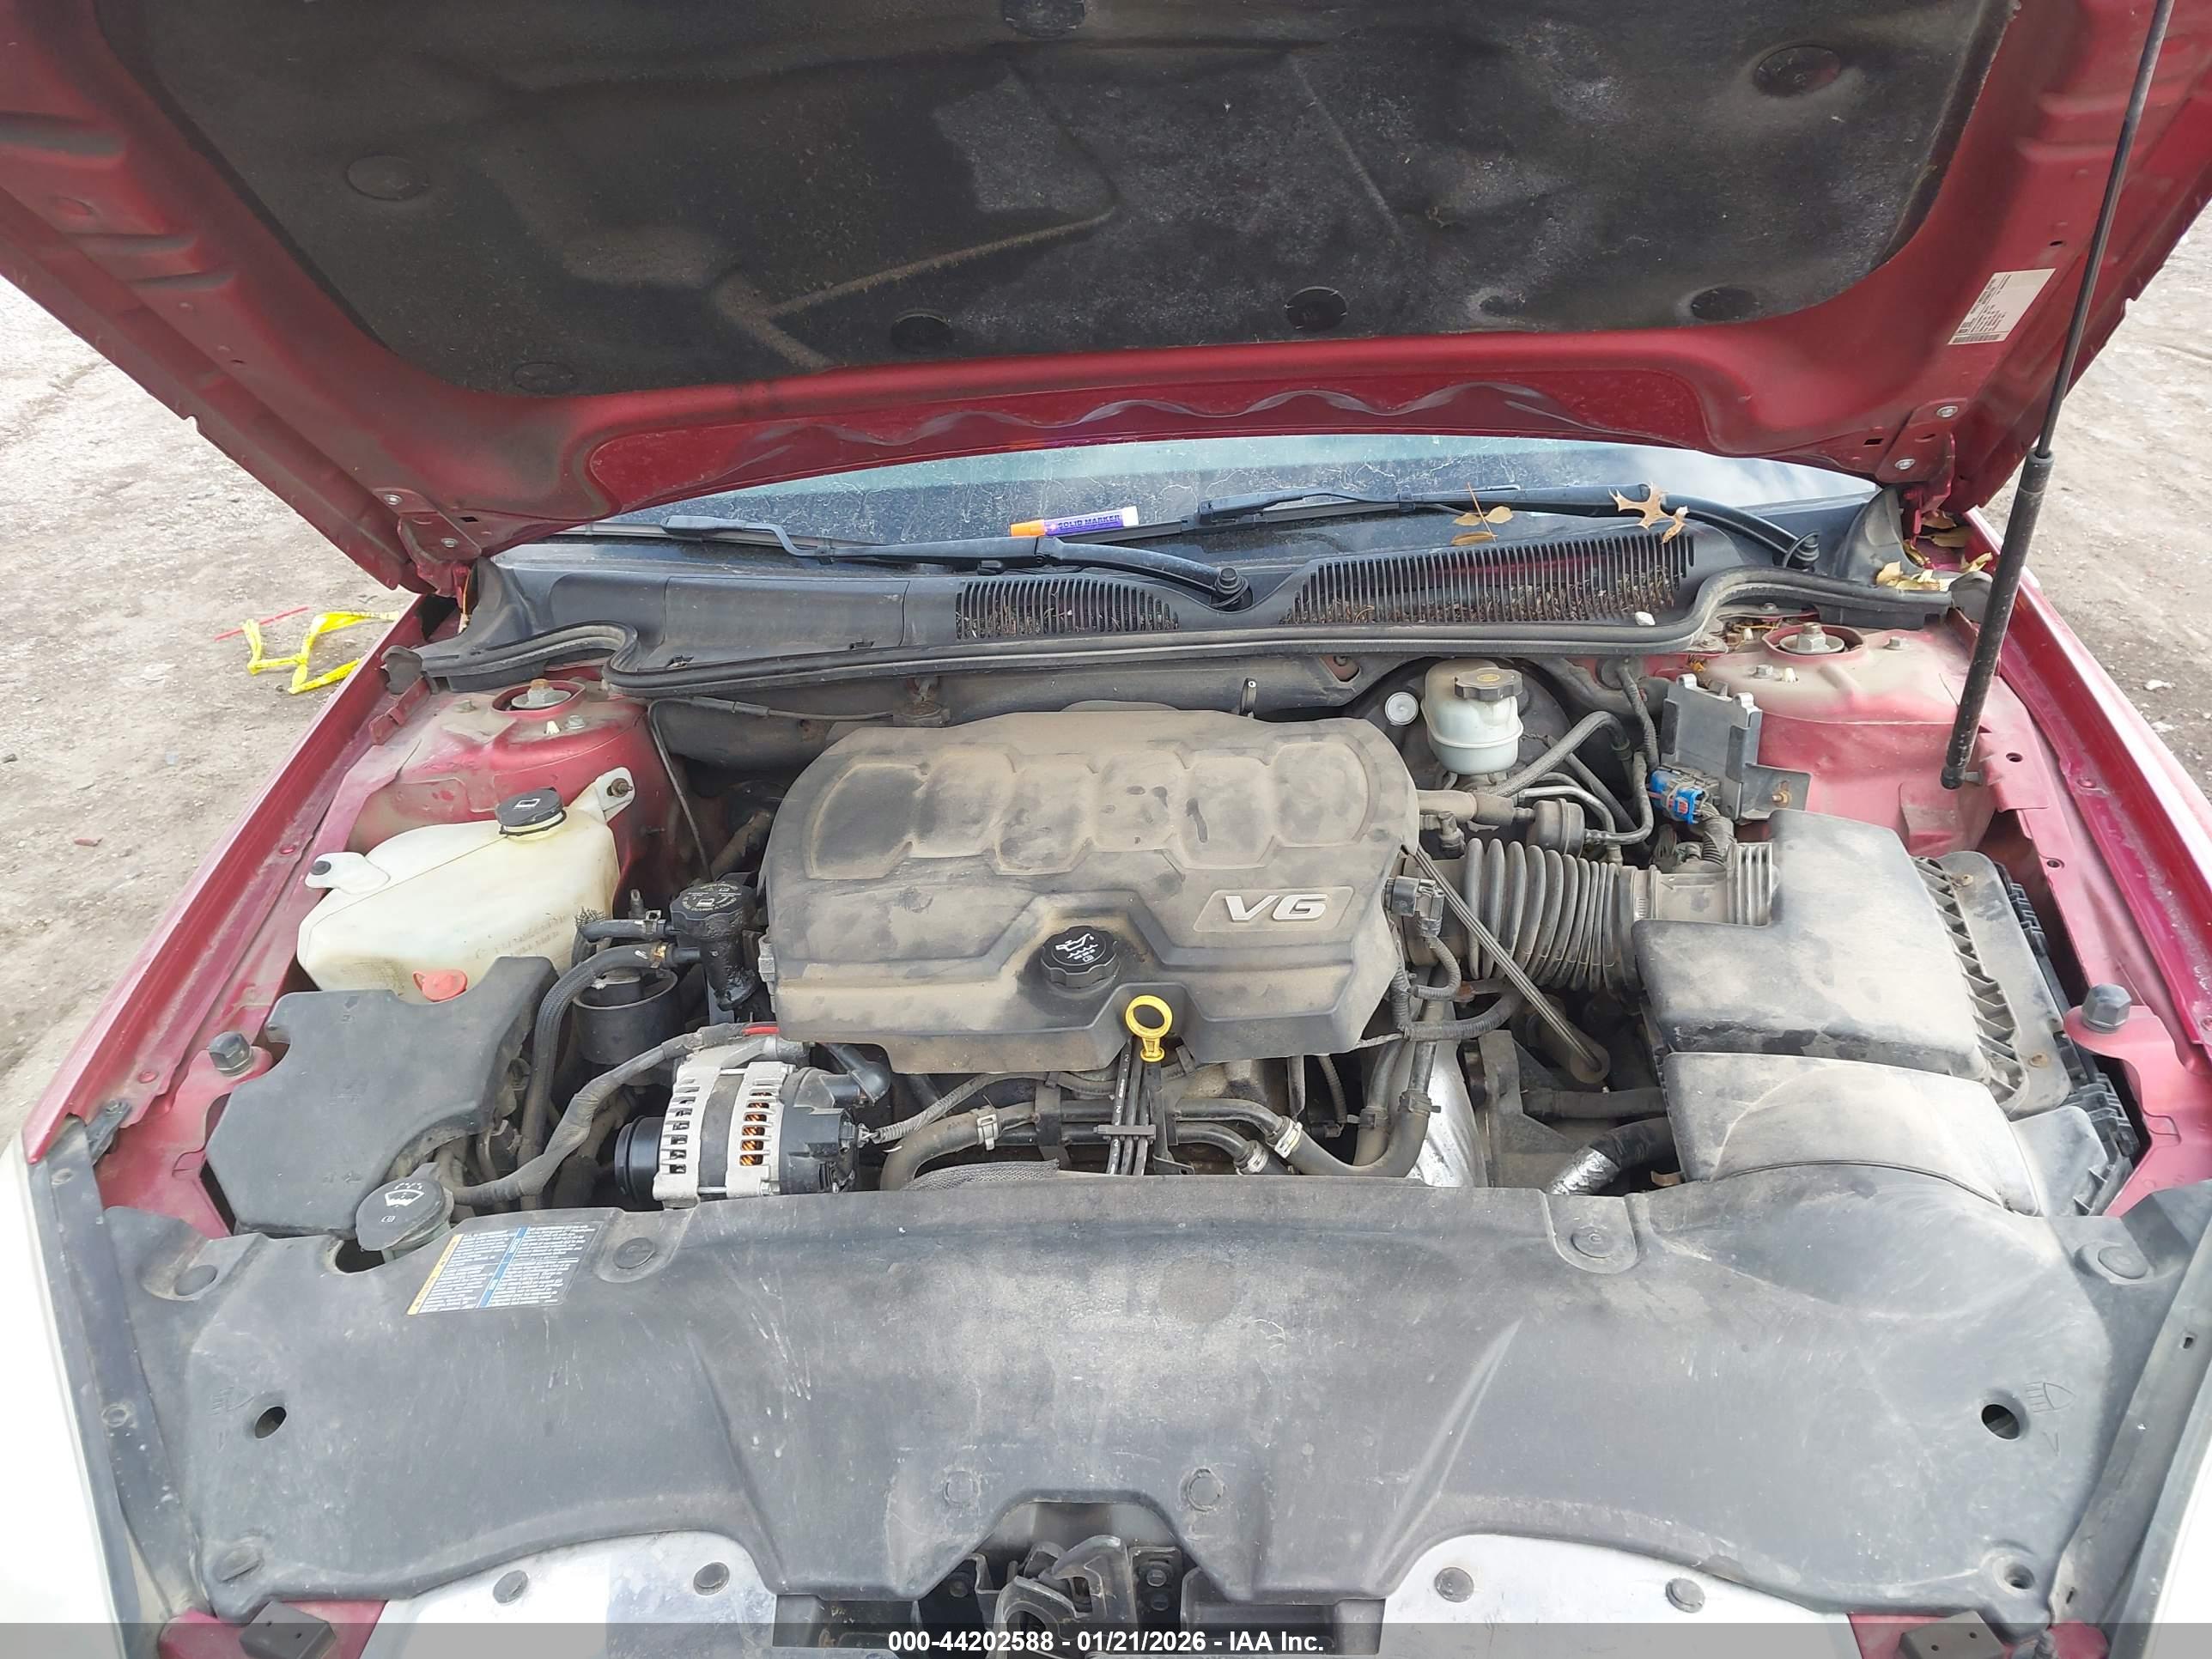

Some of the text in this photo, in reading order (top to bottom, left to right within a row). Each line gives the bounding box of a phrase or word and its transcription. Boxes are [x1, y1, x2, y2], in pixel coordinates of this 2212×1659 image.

[1057, 514, 1121, 529] SOLID MARKER
[1224, 893, 1328, 923] V6
